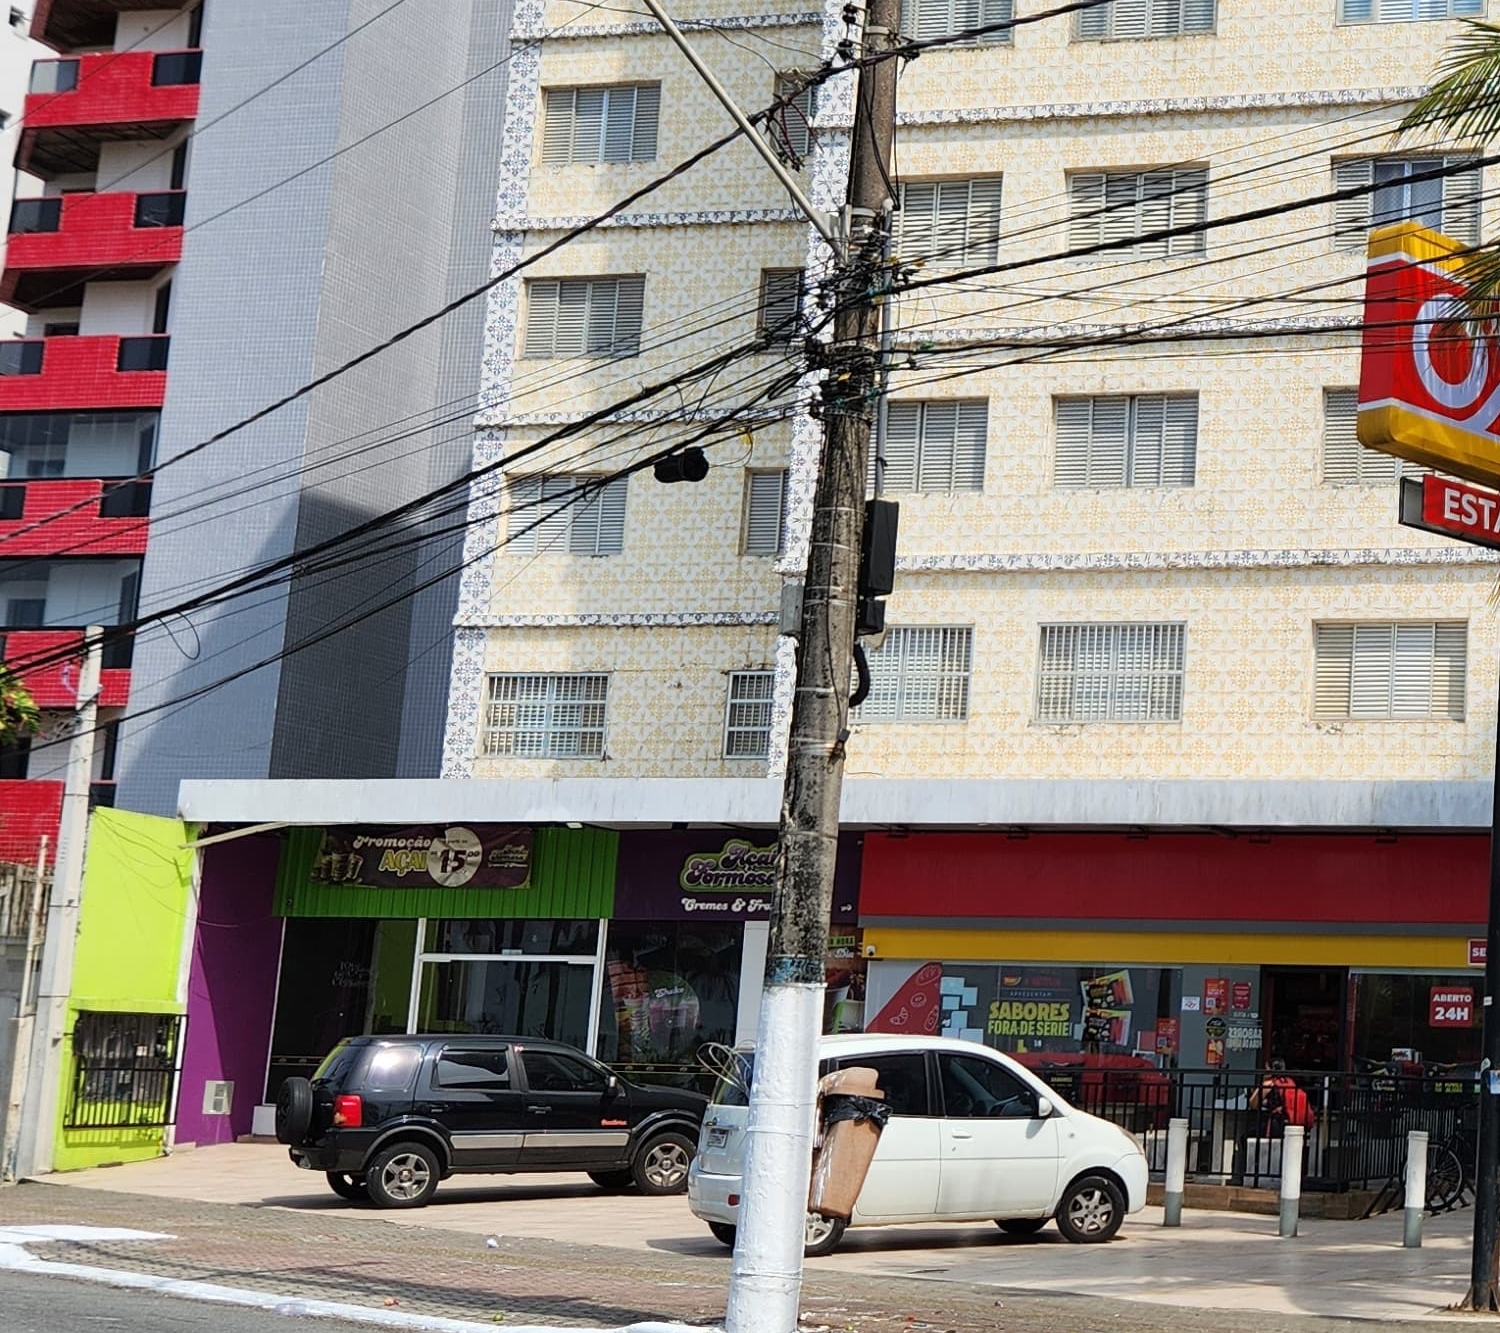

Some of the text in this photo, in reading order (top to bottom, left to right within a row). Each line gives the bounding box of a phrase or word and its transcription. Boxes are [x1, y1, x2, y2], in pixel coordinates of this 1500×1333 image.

[353, 835, 432, 850] Promoção
[681, 898, 728, 911] Cremes
[731, 898, 746, 912] &
[1433, 994, 1472, 1002] ABERTO
[989, 1001, 1070, 1020] SABORES
[1434, 1007, 1469, 1020] 24H
